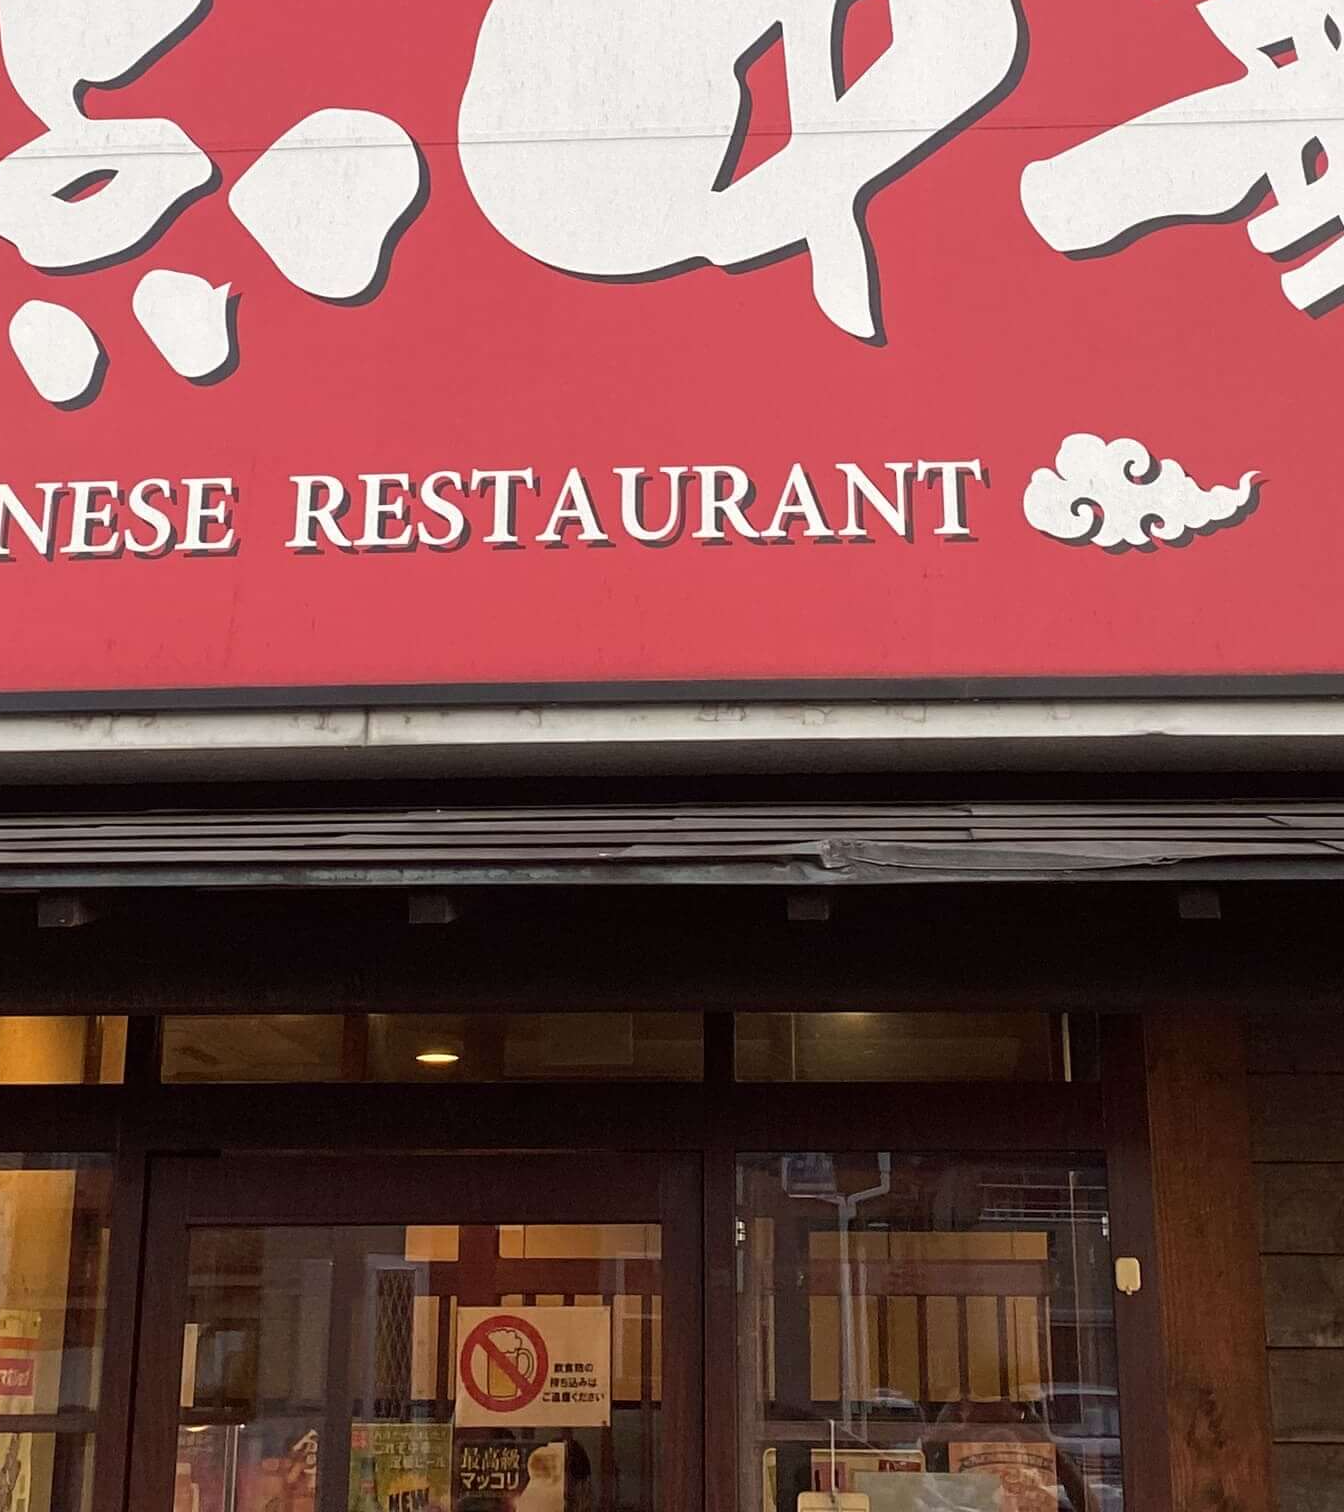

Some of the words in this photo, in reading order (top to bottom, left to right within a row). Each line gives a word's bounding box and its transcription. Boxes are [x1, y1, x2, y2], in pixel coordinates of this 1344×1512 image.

[285, 458, 989, 555] RESTAURANT
[460, 1471, 519, 1490] マッコリ
